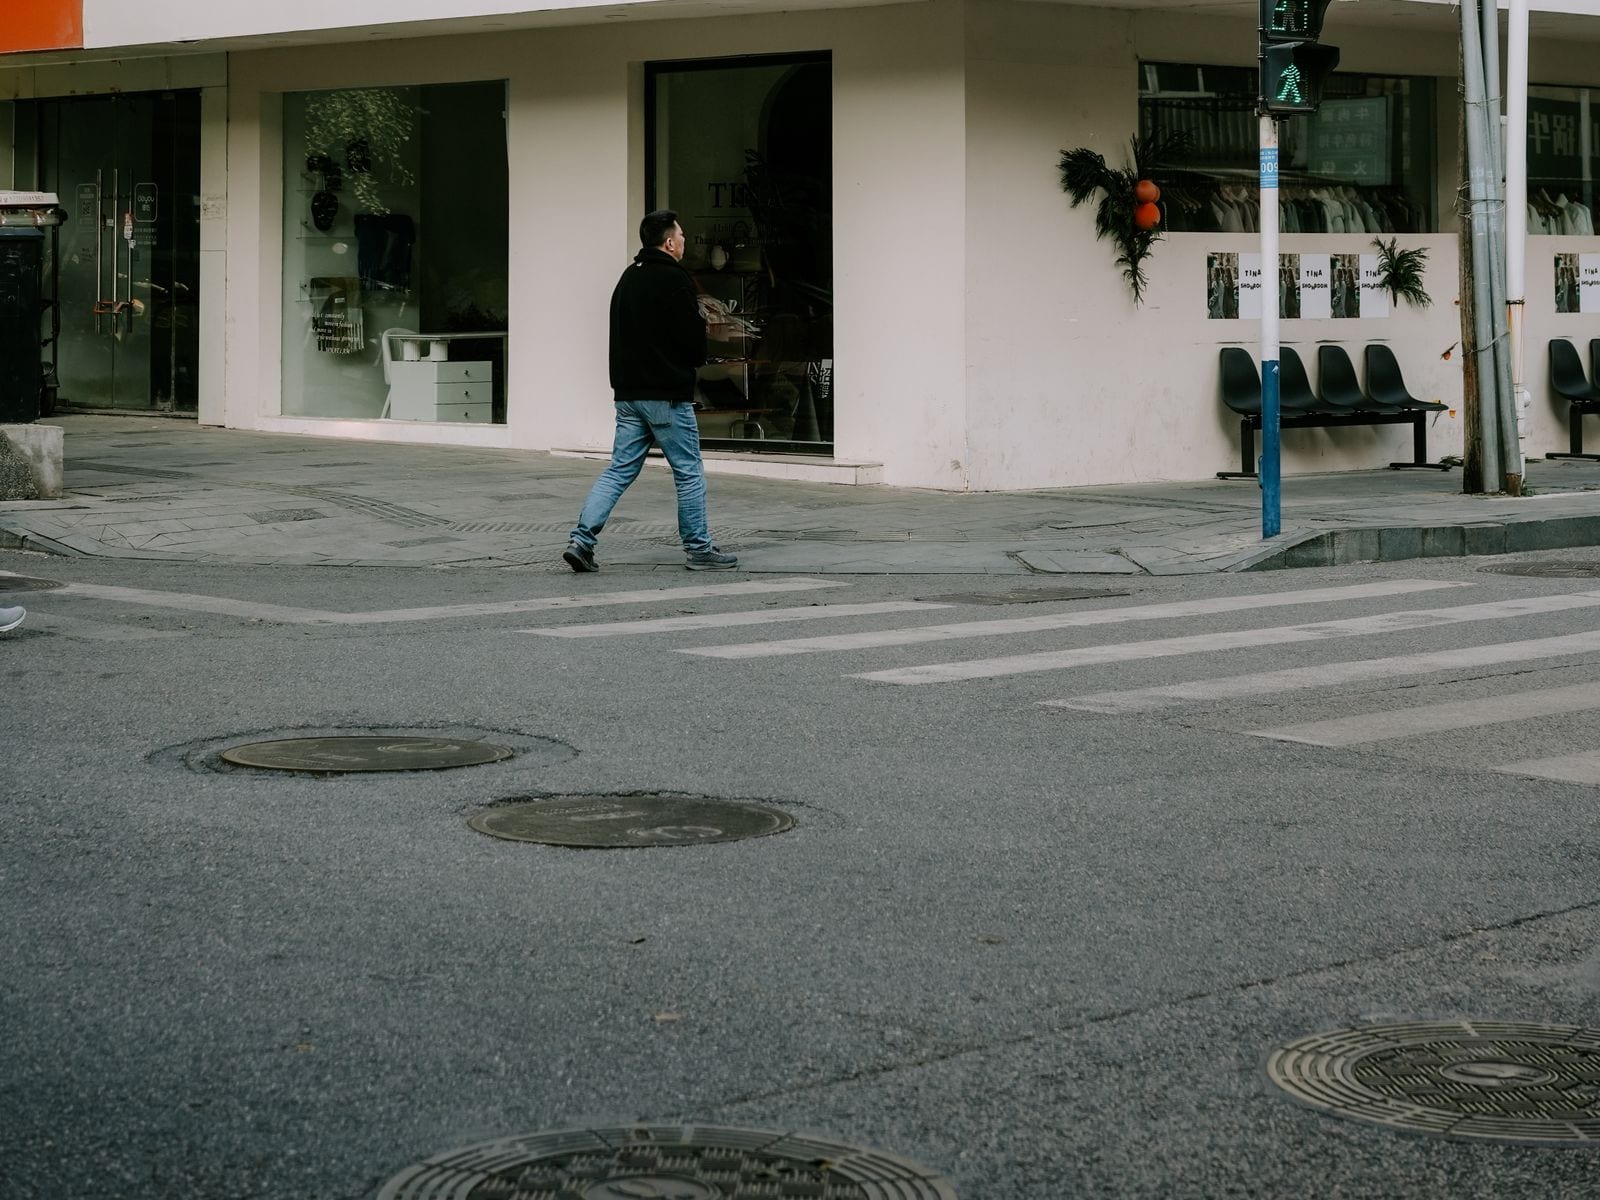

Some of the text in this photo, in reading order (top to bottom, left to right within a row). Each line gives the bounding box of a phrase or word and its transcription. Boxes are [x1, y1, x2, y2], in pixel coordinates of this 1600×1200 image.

[1245, 269, 1261, 277] TINA
[1306, 269, 1322, 277] TINA
[1365, 270, 1381, 278] TINA
